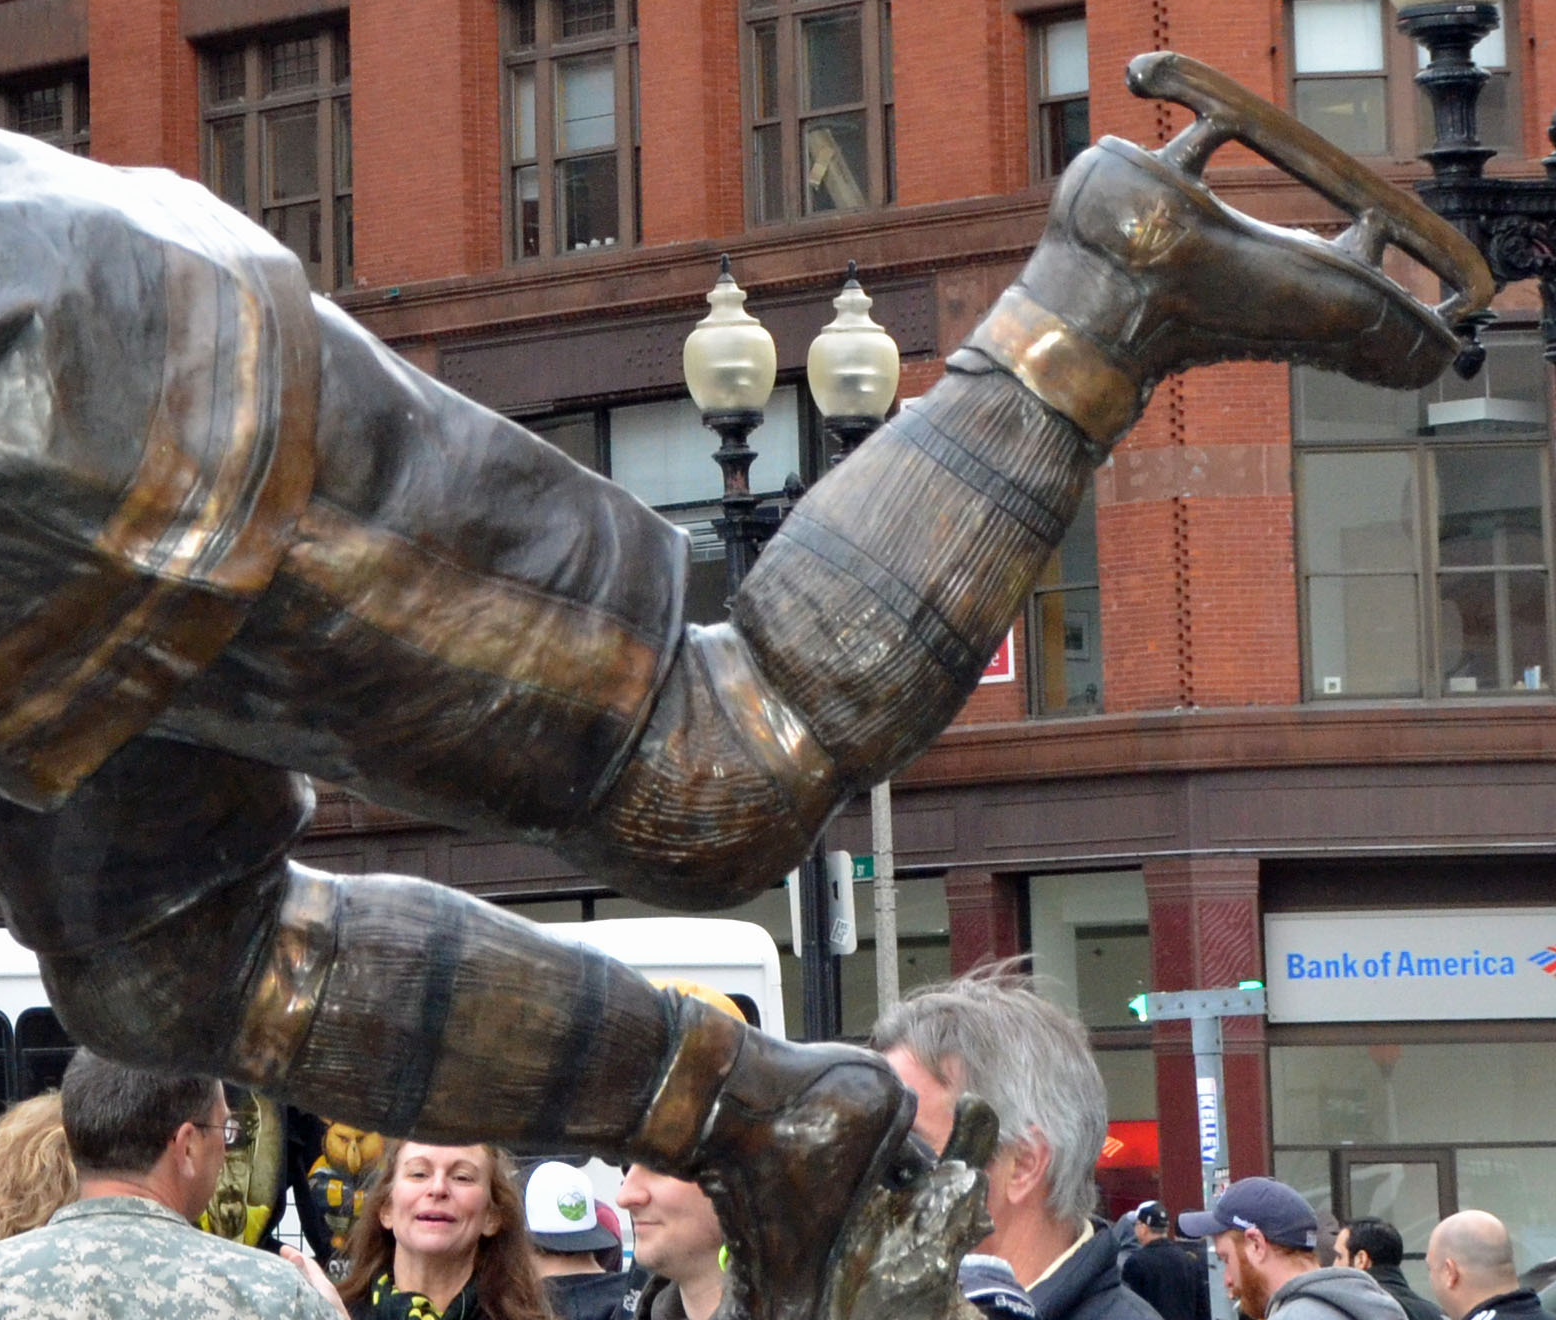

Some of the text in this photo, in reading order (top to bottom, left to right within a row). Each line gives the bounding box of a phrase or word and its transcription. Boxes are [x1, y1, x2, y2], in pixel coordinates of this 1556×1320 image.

[1286, 949, 1515, 979] Bank of America
[1198, 1092, 1218, 1162] KELLEY
